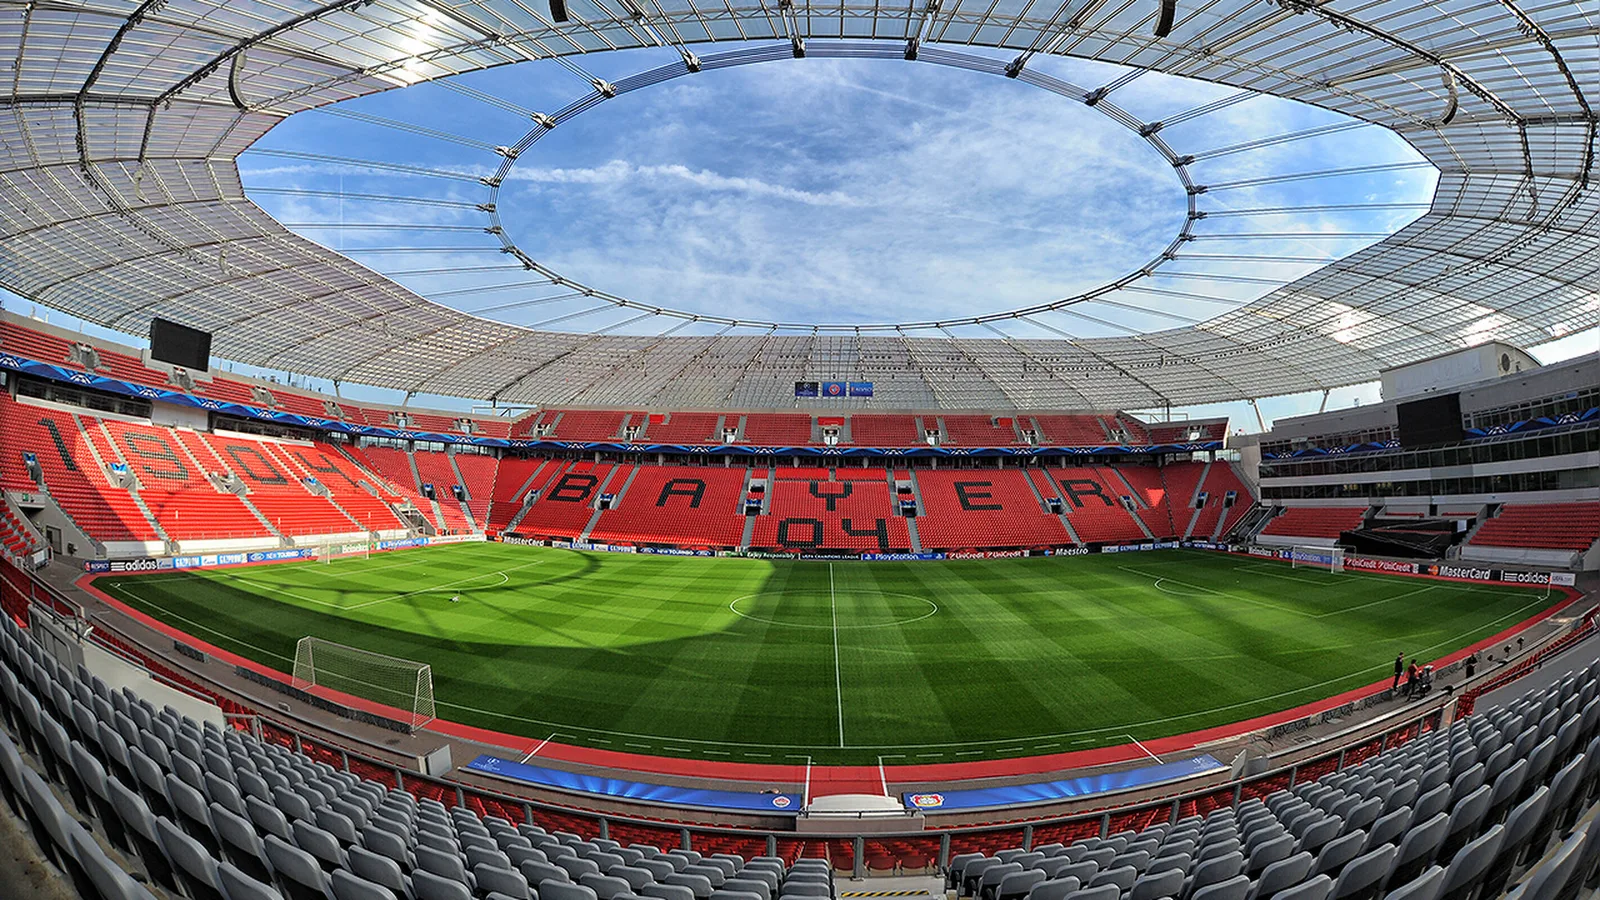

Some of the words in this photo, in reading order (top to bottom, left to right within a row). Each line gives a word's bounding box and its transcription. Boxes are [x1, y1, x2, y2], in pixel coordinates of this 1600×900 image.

[547, 474, 1114, 511] BAYER
[777, 518, 890, 549] 04
[503, 536, 545, 547] MasterCard
[747, 551, 761, 560] Enjoy
[763, 552, 796, 560] Responsibly
[875, 553, 919, 561] PlayStation
[955, 551, 984, 559] UniCredit
[991, 550, 1021, 559] UniCredit
[1055, 547, 1089, 556] Maestro
[125, 559, 157, 572] adidas
[1351, 558, 1377, 569] UniCredit
[1383, 561, 1411, 573] UniCredit
[1440, 566, 1491, 580] MasterCard
[1517, 571, 1549, 584] adidas
